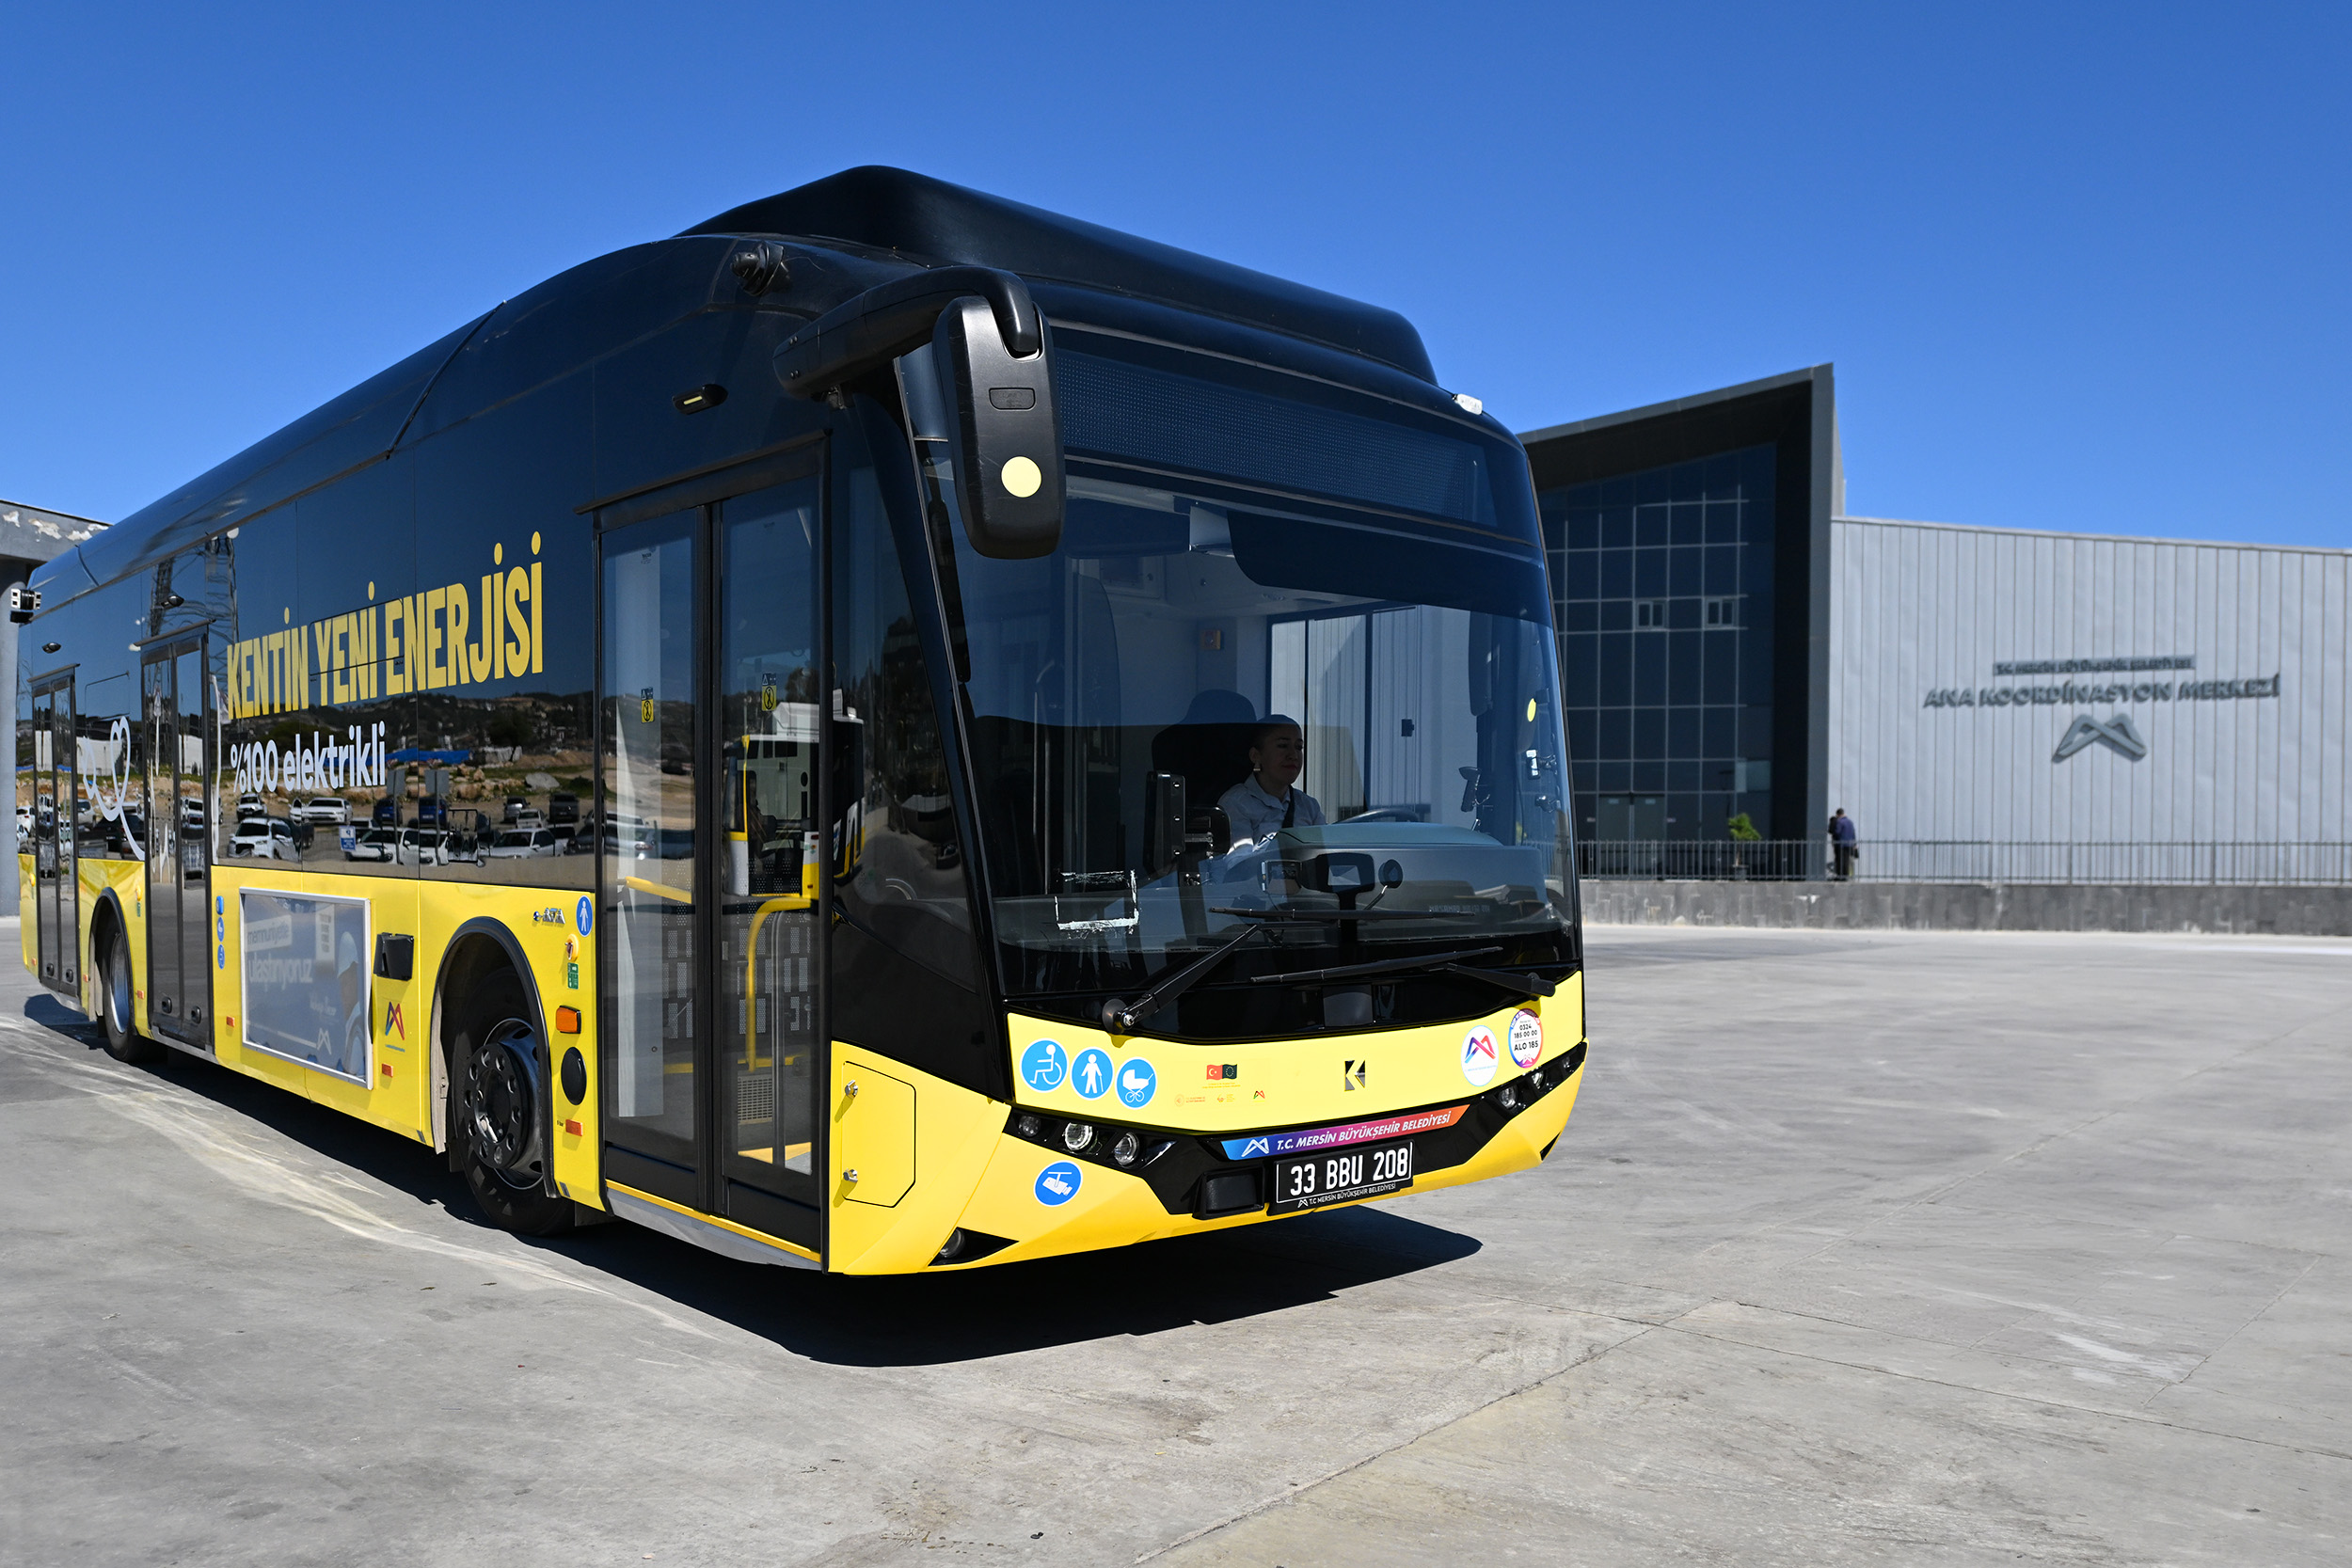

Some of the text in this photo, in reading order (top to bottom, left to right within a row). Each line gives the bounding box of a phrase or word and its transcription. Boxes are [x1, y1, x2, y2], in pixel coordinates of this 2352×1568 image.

[227, 531, 544, 721] KENTİN YENİ ENERJİSİ
[1923, 673, 2281, 707] ANA KOORDİNASYON MERKEZİ
[230, 721, 386, 794] %100 elektrikli
[1514, 1040, 1539, 1051] ALO 185
[1277, 1111, 1452, 1151] T.C. MERSİN BÜYÜKŞEHİR BELEDİYESİ
[1290, 1147, 1409, 1196] 33 BBU 208
[1317, 1194, 1337, 1204] MERSİN
[1337, 1188, 1368, 1199] BÜYÜKŞEHİR
[1369, 1182, 1396, 1194] BELEDİYESİ
